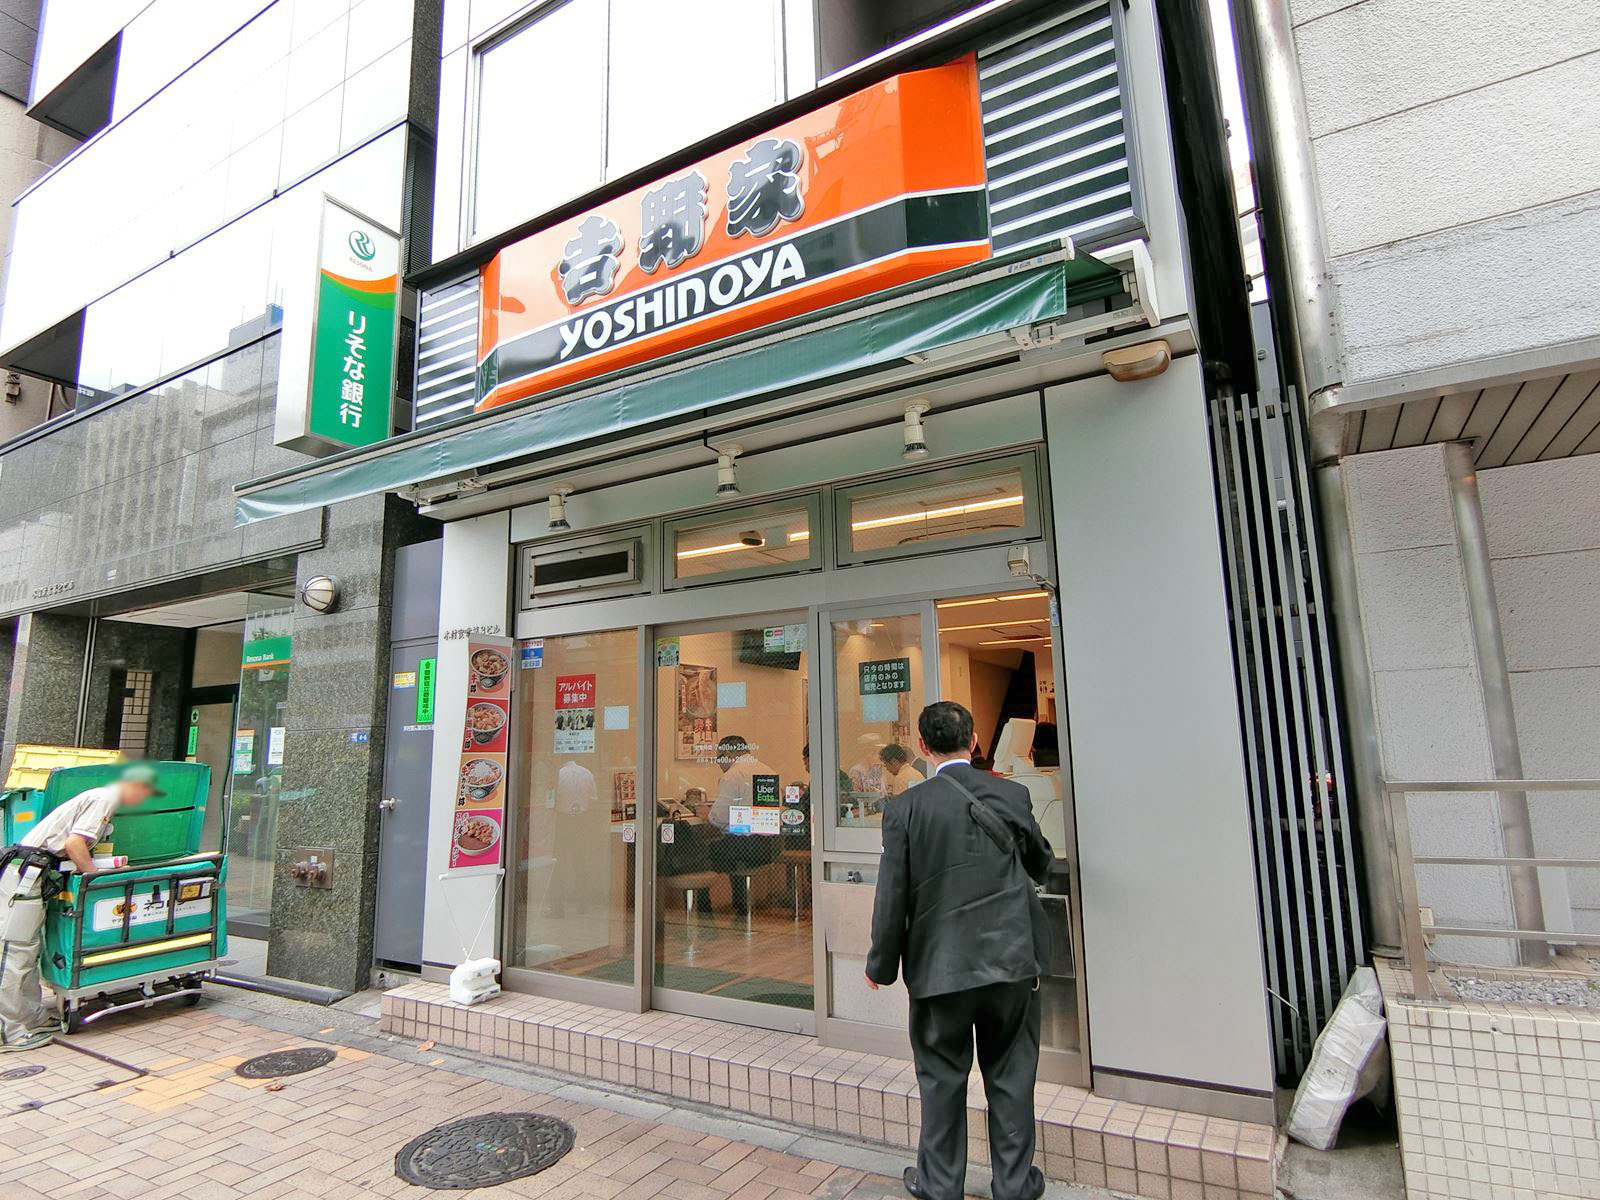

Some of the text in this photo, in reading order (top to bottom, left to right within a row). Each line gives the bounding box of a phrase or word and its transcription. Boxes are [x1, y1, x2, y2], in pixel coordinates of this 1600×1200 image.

[348, 256, 373, 272] RESONA
[558, 243, 807, 361] YOSHINOYA
[339, 311, 367, 428] りそな銀行
[246, 653, 274, 663] Resona Bank
[863, 662, 905, 674] 只今の時間は
[863, 672, 899, 682] 店内のみの
[558, 680, 593, 692] アルバイト
[864, 681, 905, 691] 販売となります
[563, 693, 587, 704] 募集中
[757, 784, 775, 794] Uber
[757, 794, 776, 802] Eats
